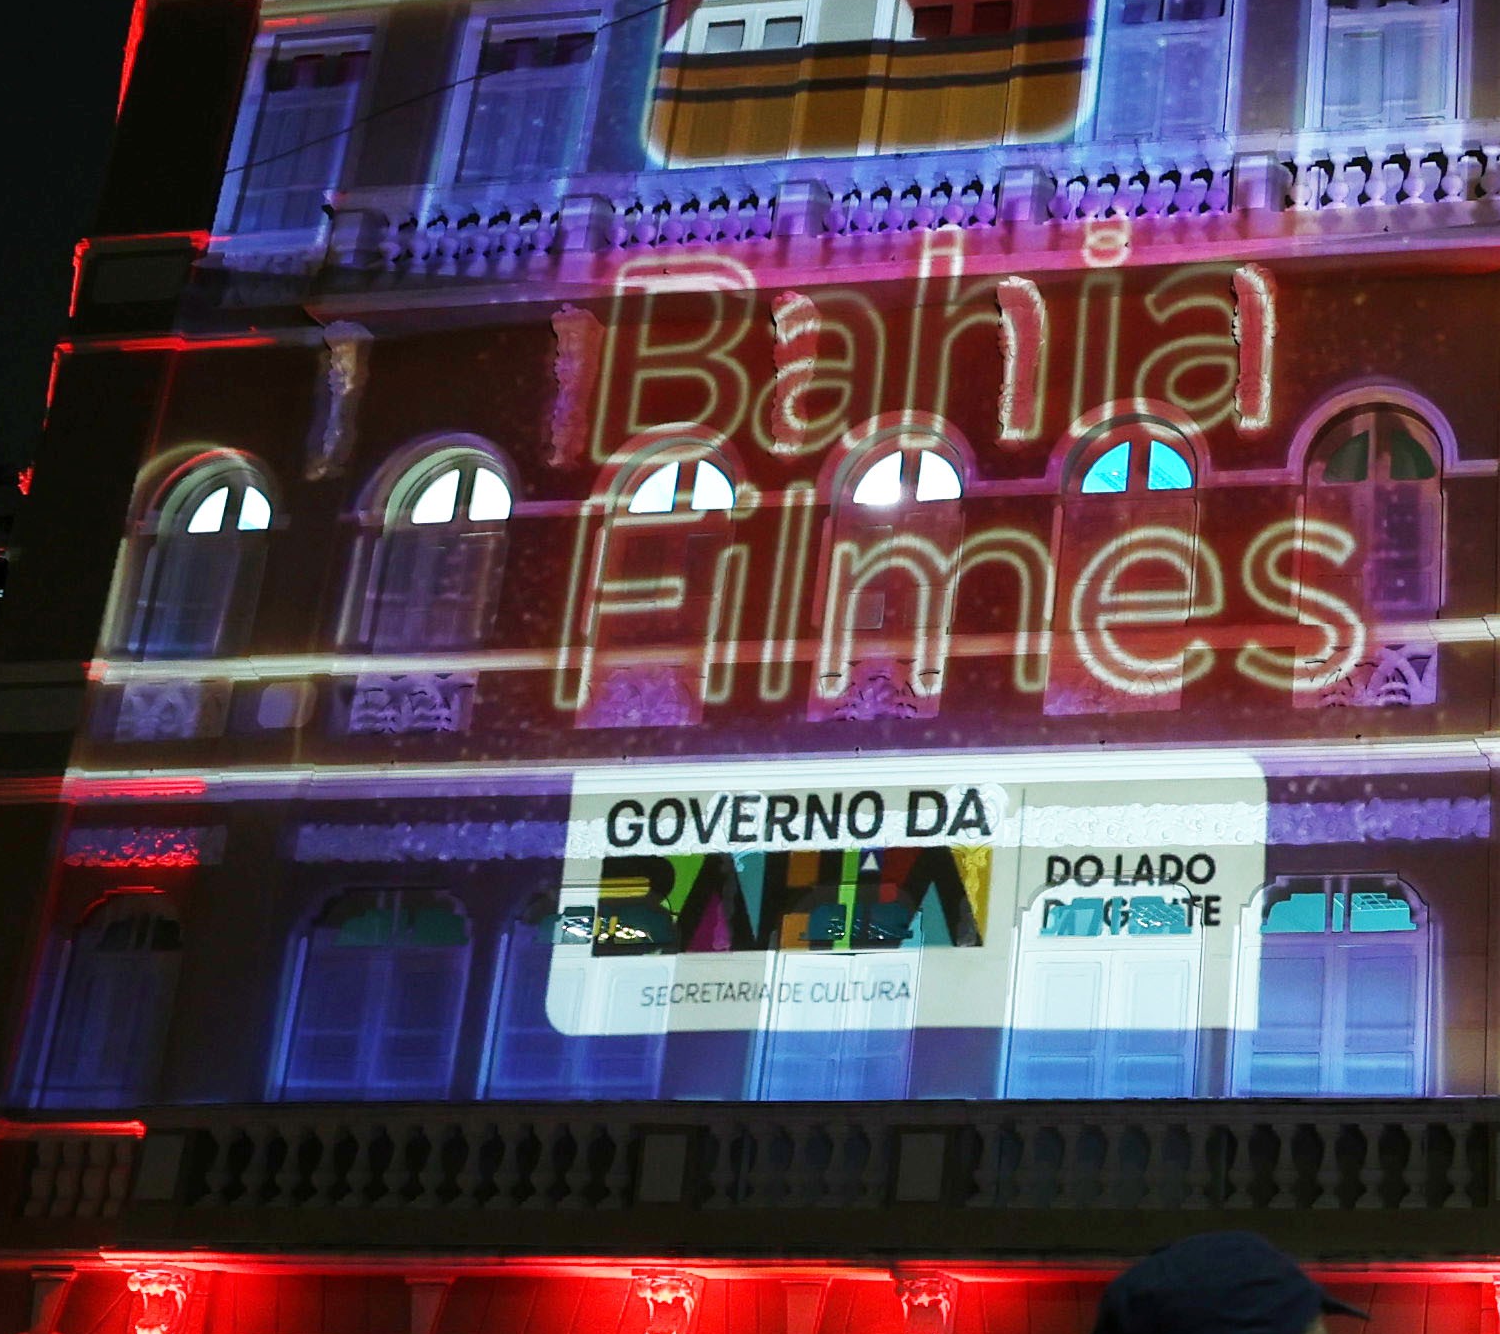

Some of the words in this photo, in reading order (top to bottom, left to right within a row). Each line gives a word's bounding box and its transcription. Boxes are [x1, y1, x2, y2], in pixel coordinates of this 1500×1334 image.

[591, 216, 1262, 465] Bahia
[553, 482, 1366, 711] Filmes
[606, 789, 886, 848] GOVERNO
[905, 787, 992, 839] DA
[1046, 854, 1104, 887] DO
[1113, 852, 1216, 887] LADO
[641, 980, 772, 1008] SECRETARIA
[779, 981, 804, 1003] DE
[809, 979, 912, 1004] CULTURA
